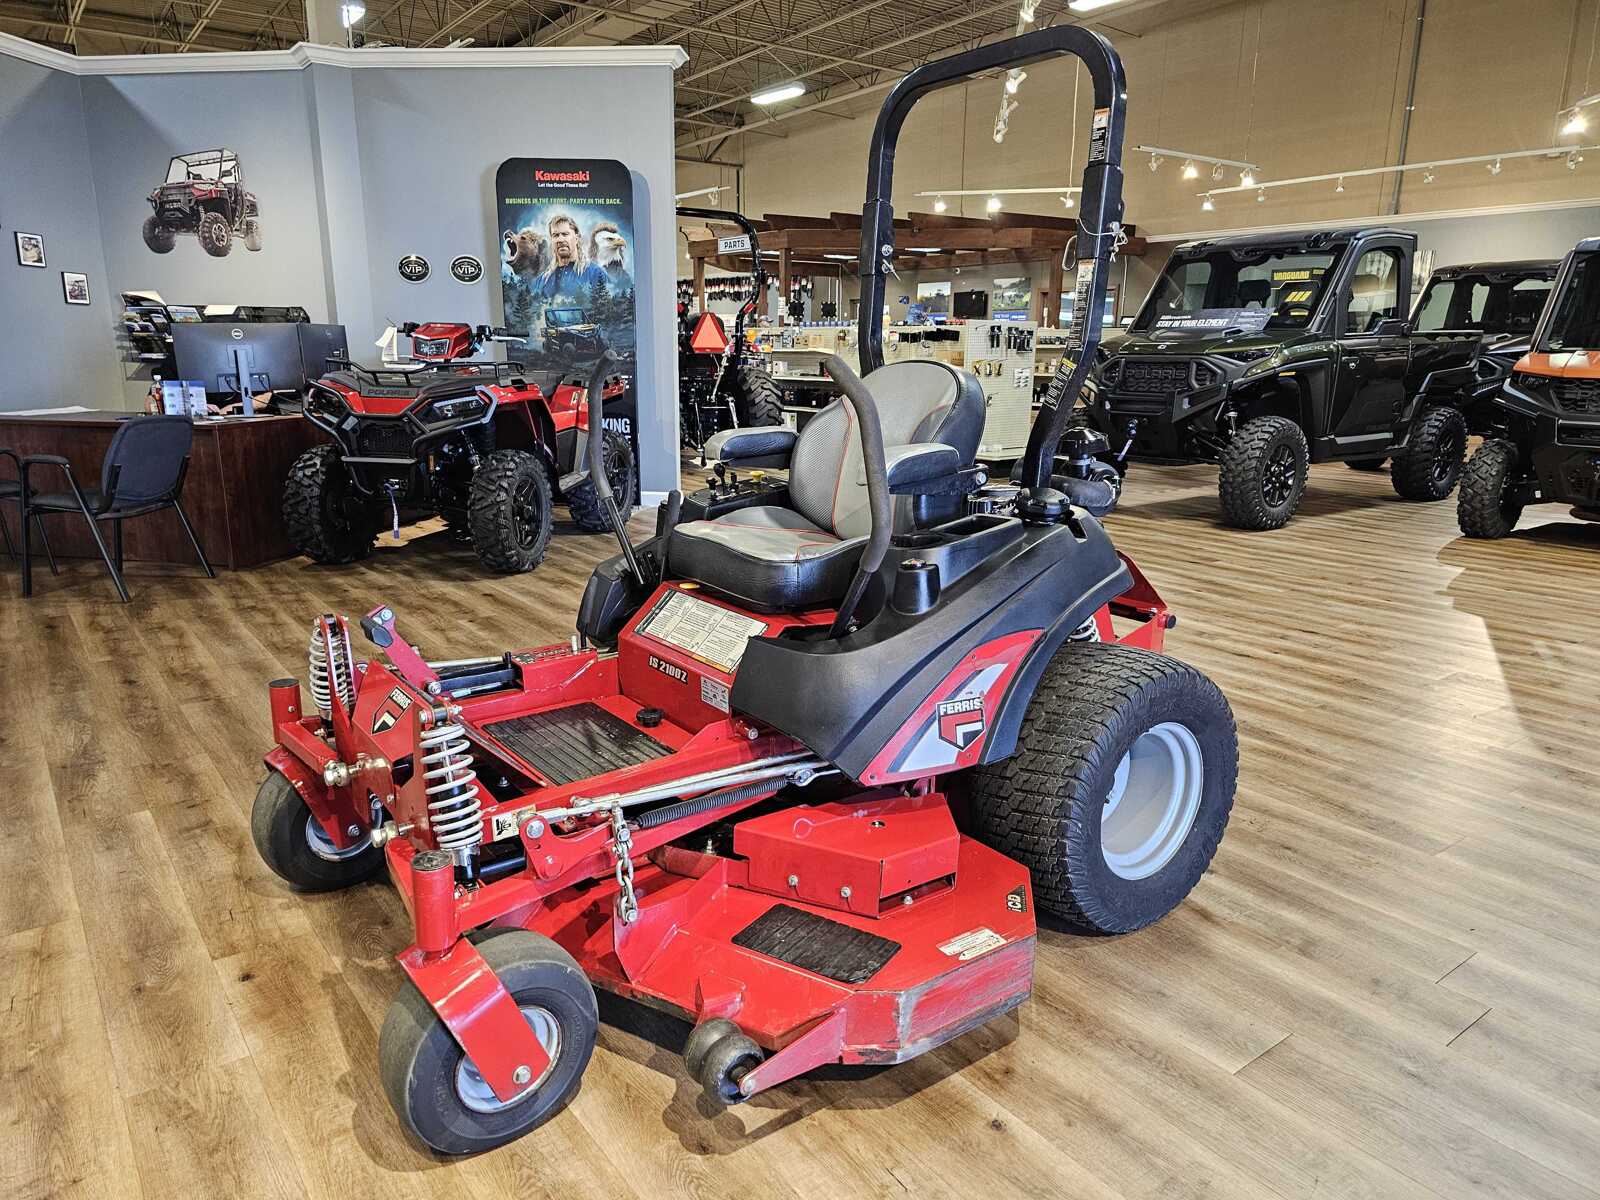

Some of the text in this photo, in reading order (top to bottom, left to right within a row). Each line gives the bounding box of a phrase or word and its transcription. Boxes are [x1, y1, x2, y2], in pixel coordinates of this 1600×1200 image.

[535, 170, 590, 181] Kawasaki
[724, 239, 745, 249] PARTS
[404, 265, 422, 274] VIP
[457, 265, 475, 274] VIP
[1156, 319, 1172, 328] STAY
[1172, 319, 1180, 328] IN
[1180, 319, 1198, 328] YOUR
[1197, 319, 1229, 328] ELEMENT
[1126, 368, 1186, 379] POLARIS
[940, 698, 982, 716] FERRIS
